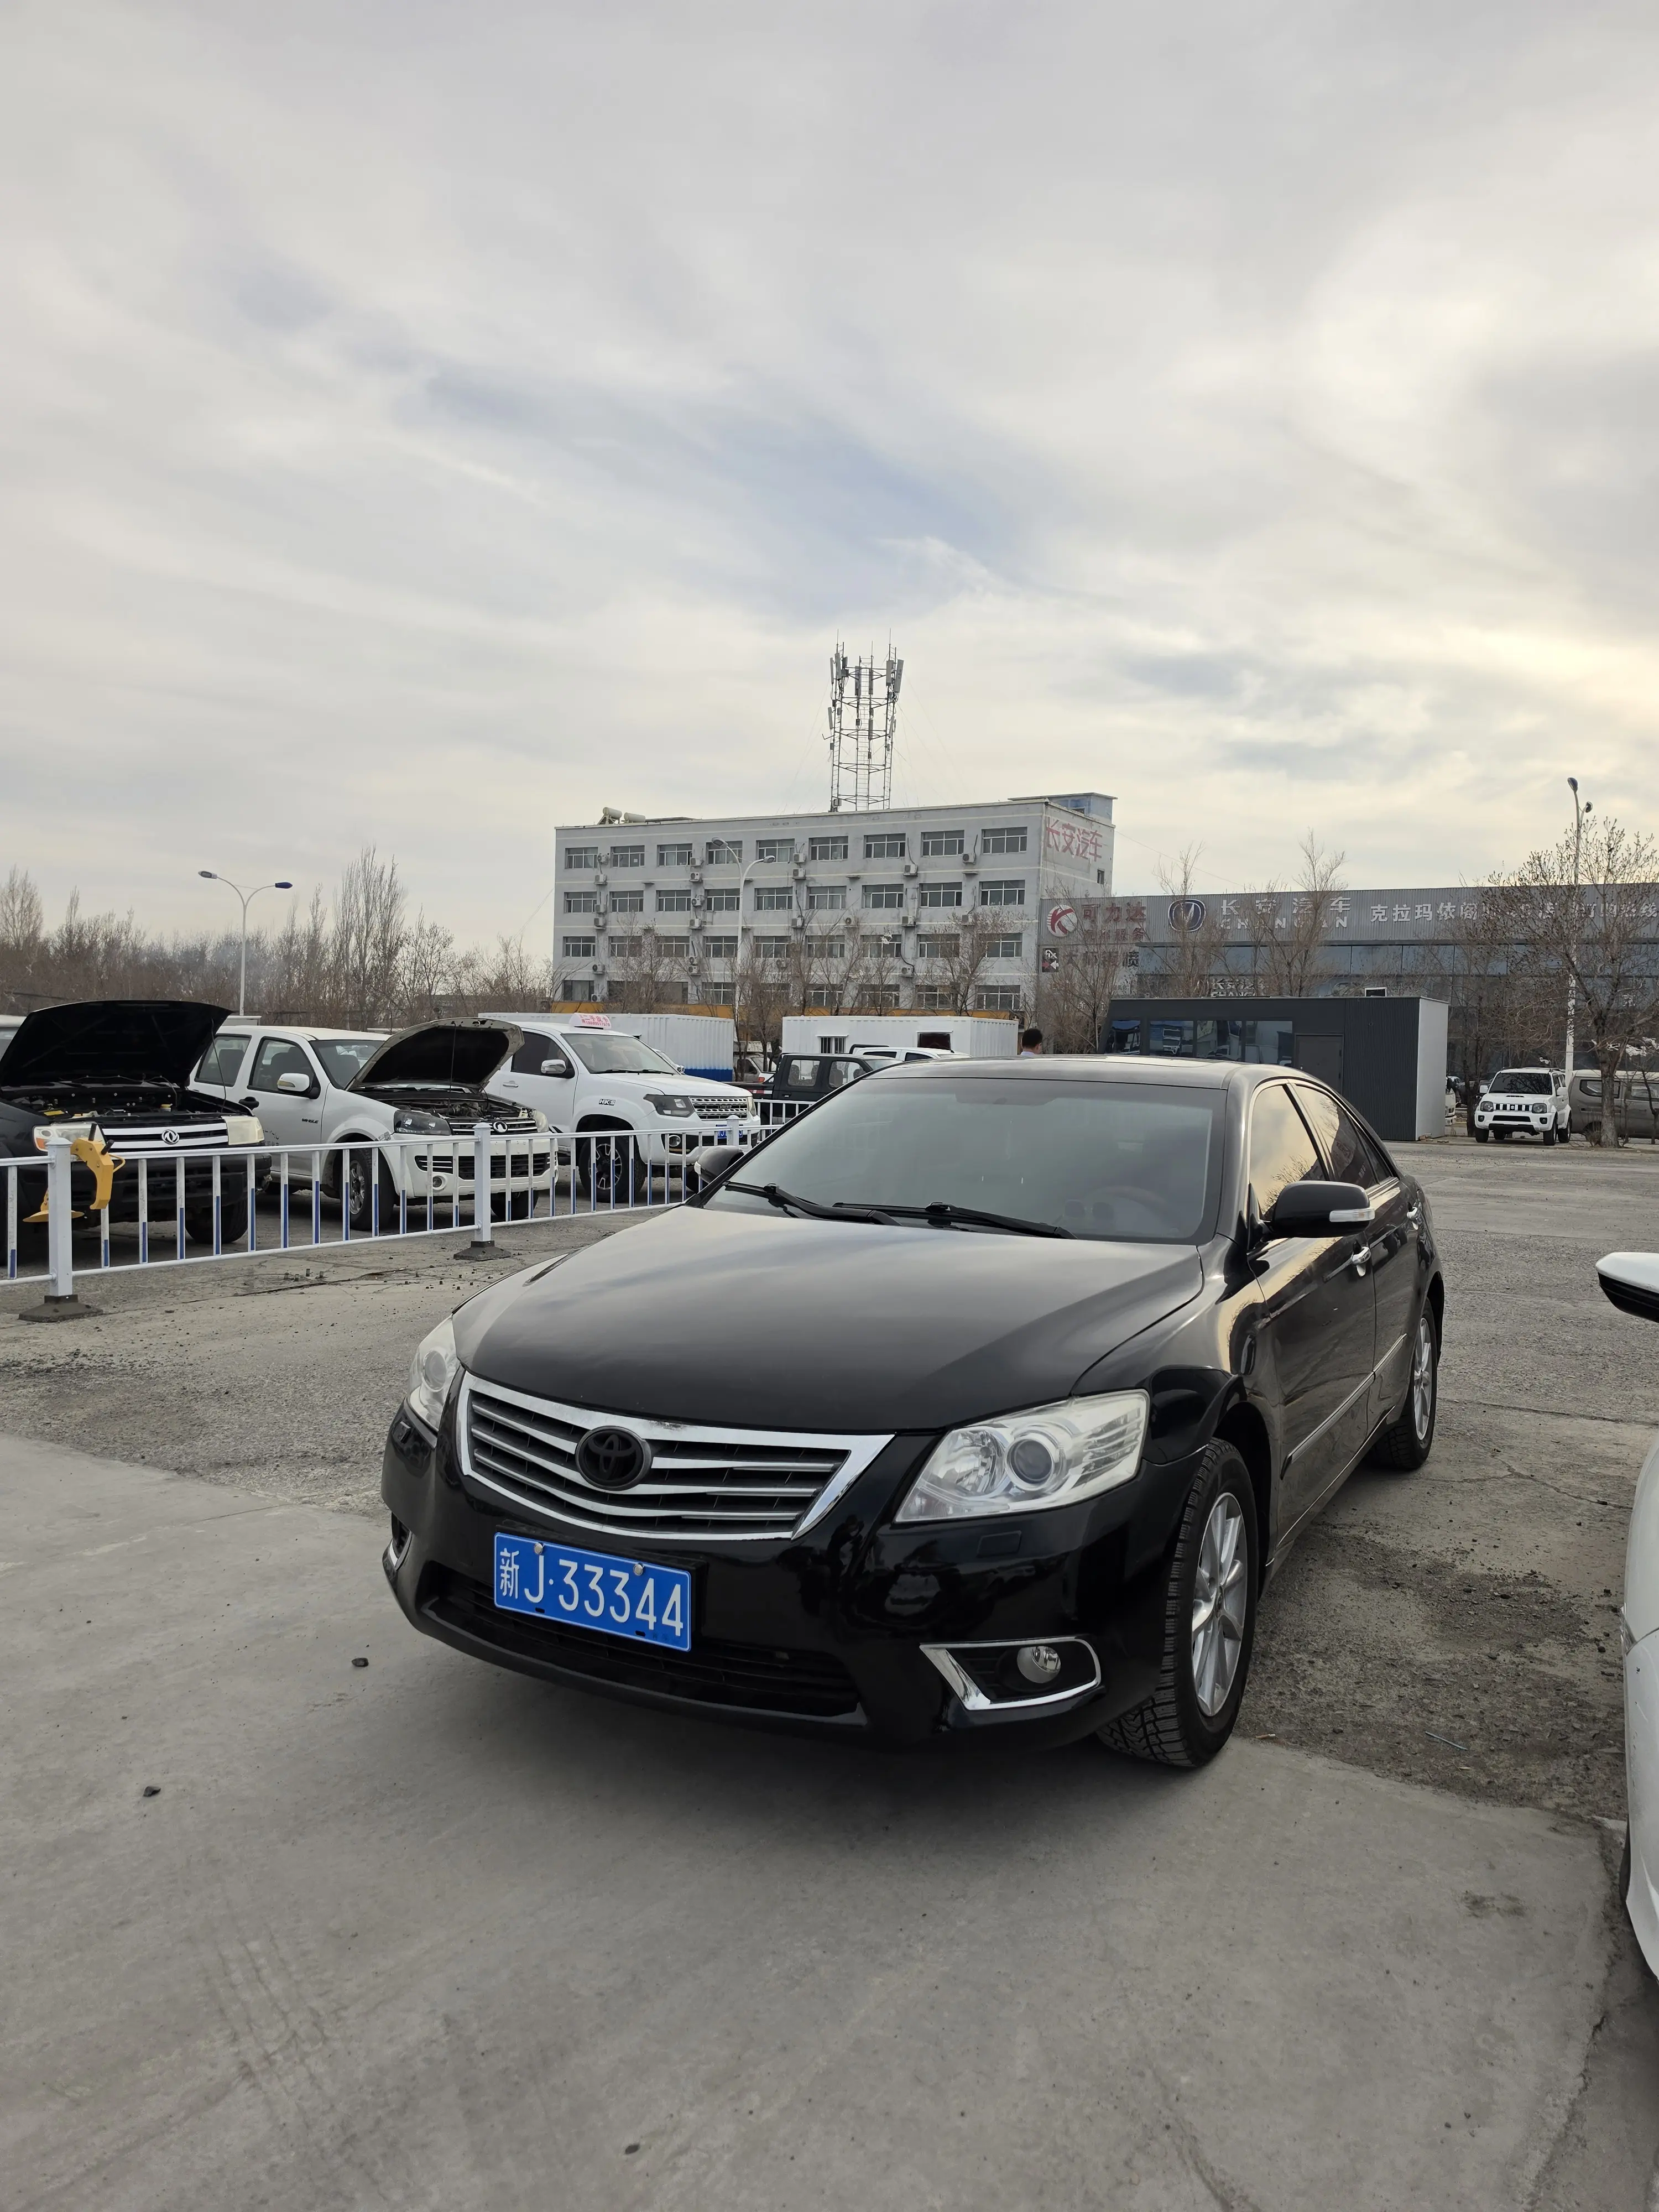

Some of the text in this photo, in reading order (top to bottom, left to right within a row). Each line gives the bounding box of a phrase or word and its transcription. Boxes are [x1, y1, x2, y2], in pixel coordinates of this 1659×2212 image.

[1046, 817, 1103, 862] 长安汽车
[1220, 896, 1351, 915] 长安汽车
[1220, 916, 1348, 930] CHNGAN
[500, 1547, 684, 1636] 新J·33344
